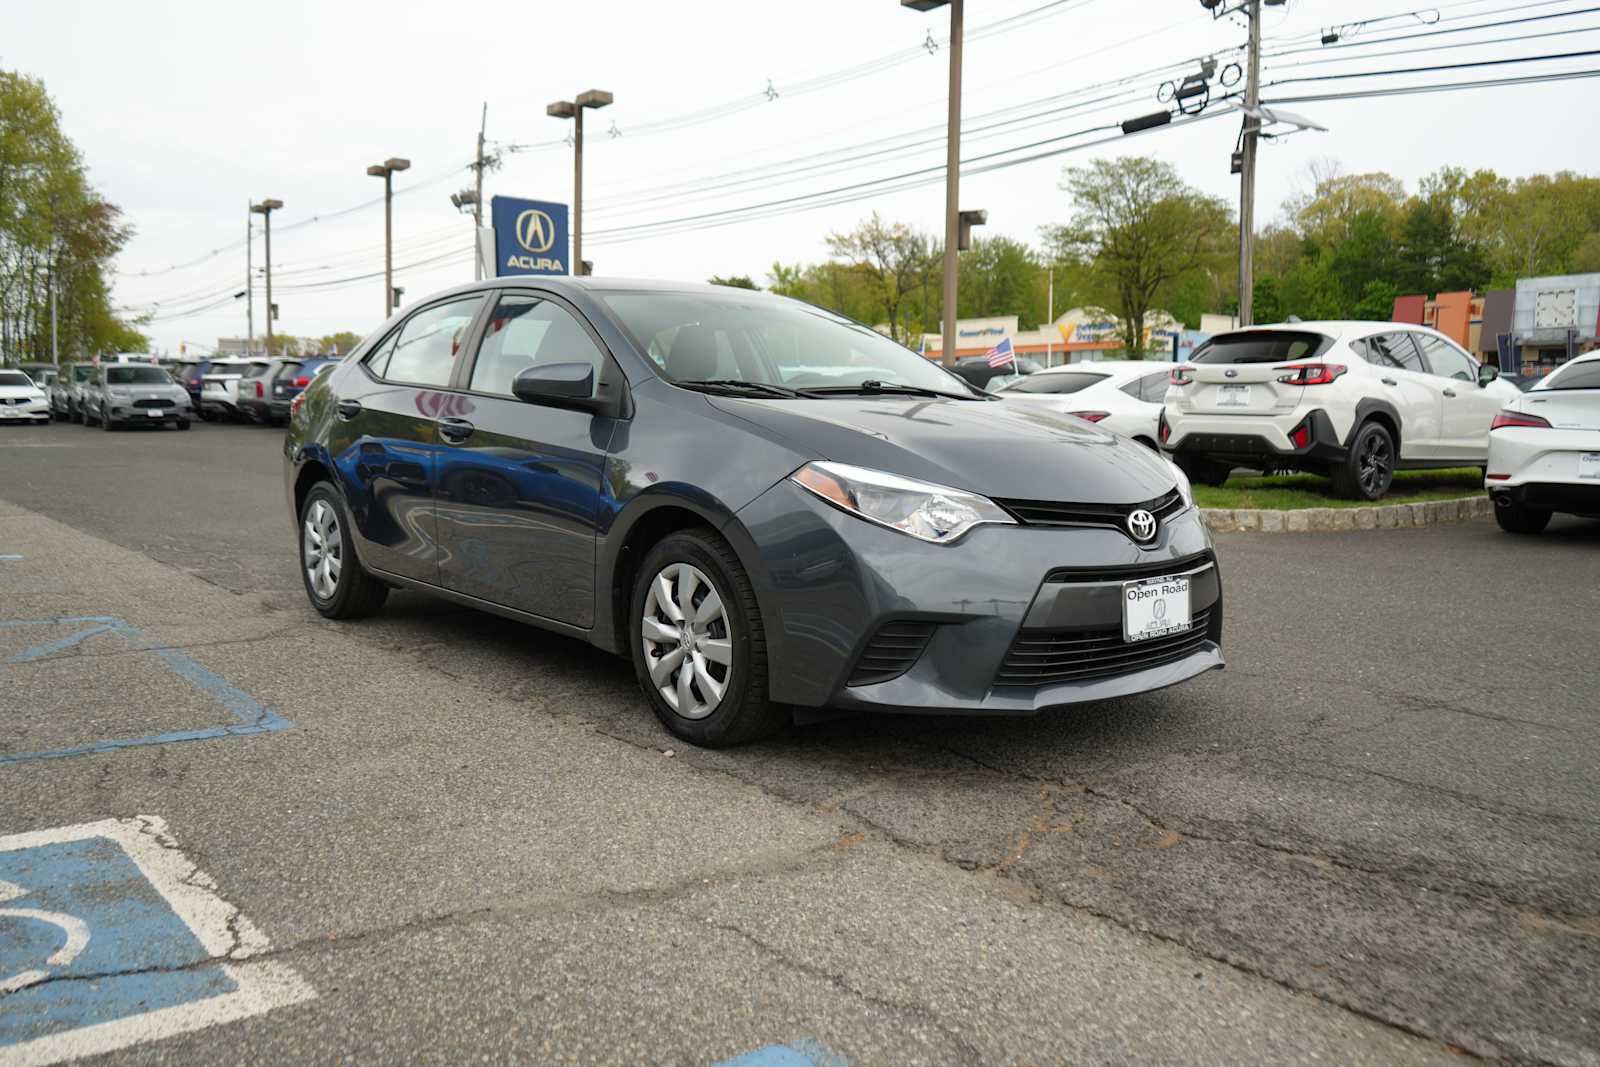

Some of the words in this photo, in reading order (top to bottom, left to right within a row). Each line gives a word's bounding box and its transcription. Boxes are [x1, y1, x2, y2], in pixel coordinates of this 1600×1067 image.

[507, 255, 564, 272] ACURA
[1127, 589, 1158, 601] Open
[1162, 582, 1188, 595] Road
[1131, 632, 1149, 641] OPEN
[1150, 629, 1168, 638] ROAD
[1168, 625, 1189, 634] ACURA
